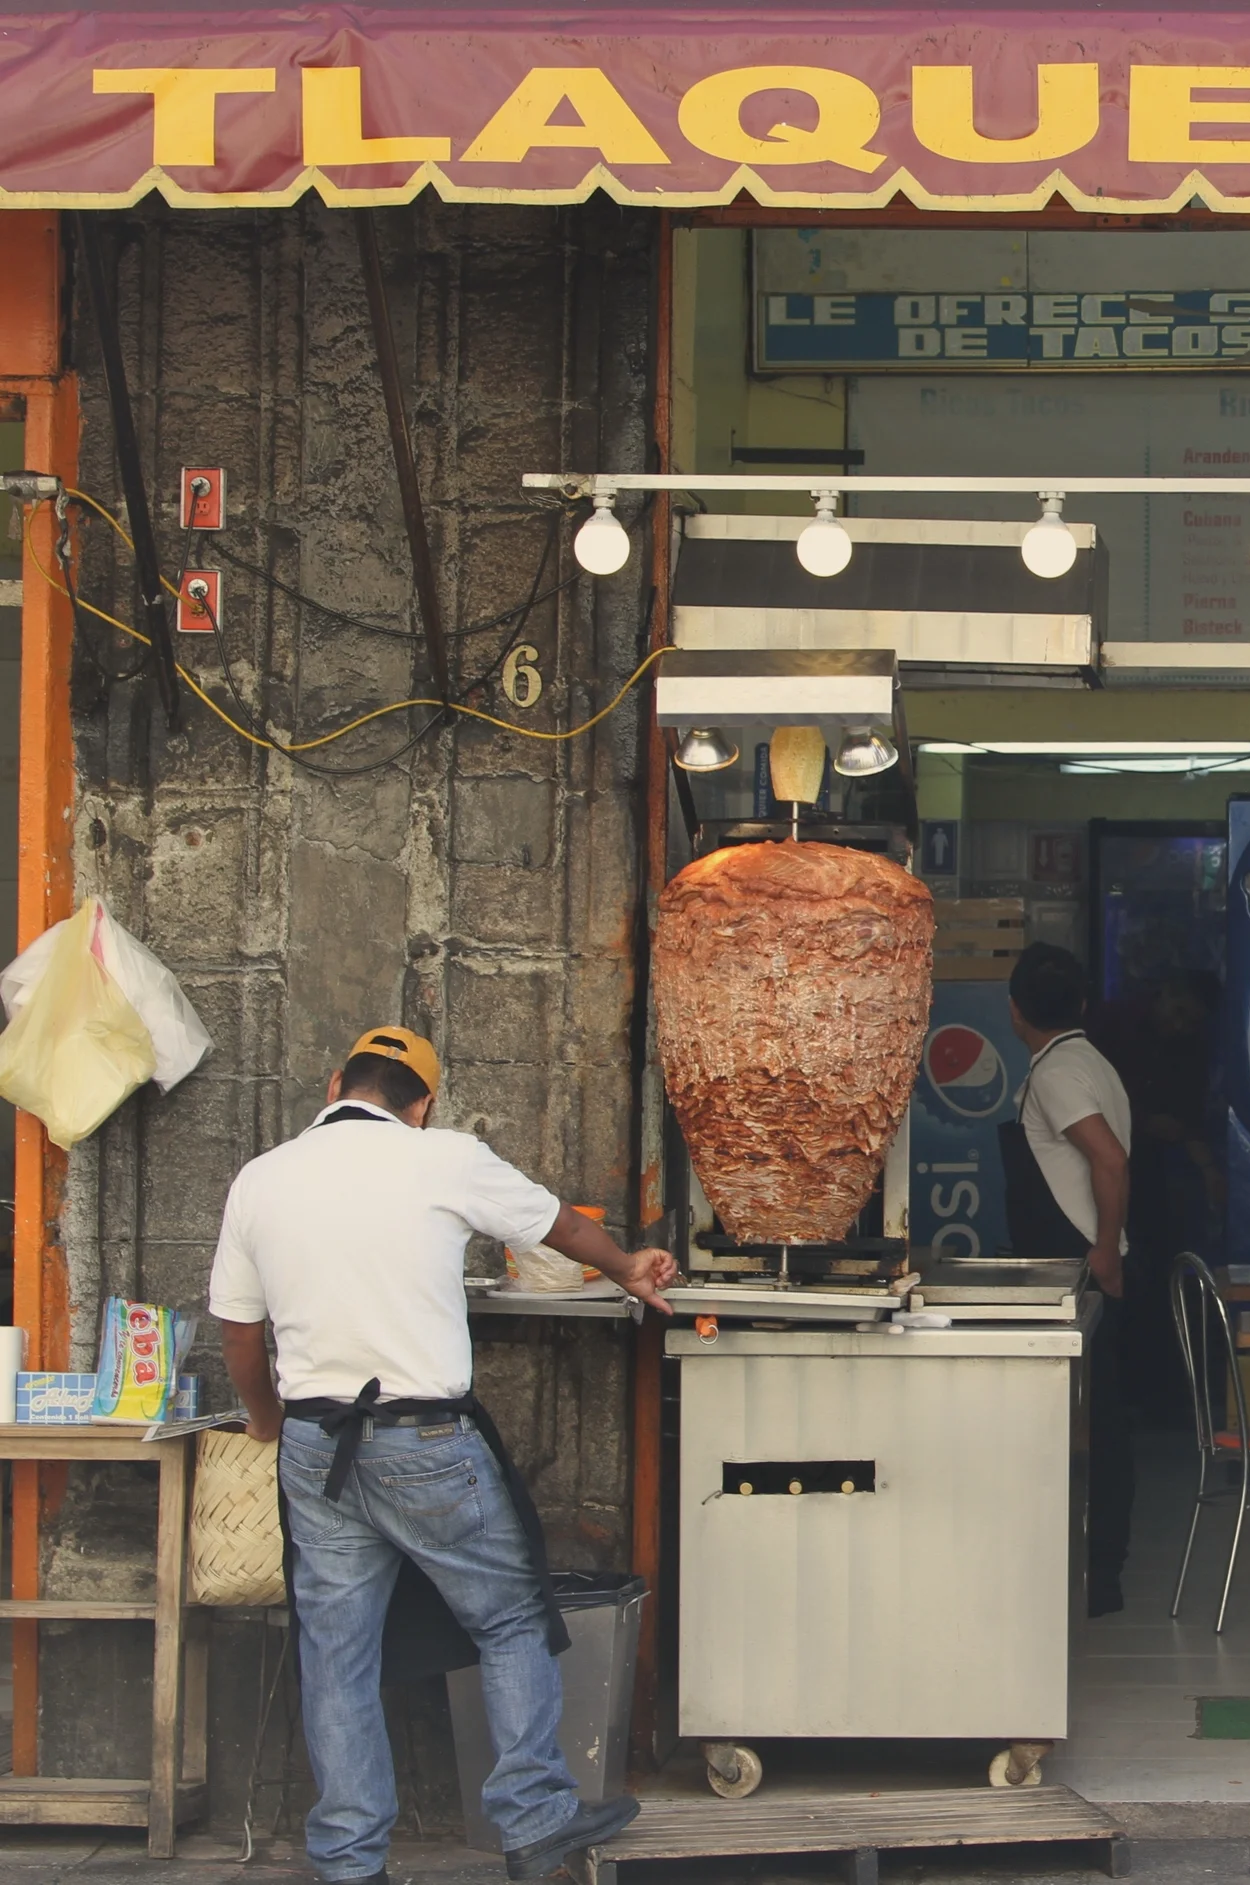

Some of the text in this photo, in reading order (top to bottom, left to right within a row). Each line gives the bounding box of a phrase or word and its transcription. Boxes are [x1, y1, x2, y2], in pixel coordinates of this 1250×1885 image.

[769, 296, 856, 325] LE
[894, 293, 1175, 325] OFRECE
[898, 328, 988, 358] DE
[1182, 618, 1243, 636] Bisteck
[501, 644, 543, 708] 6
